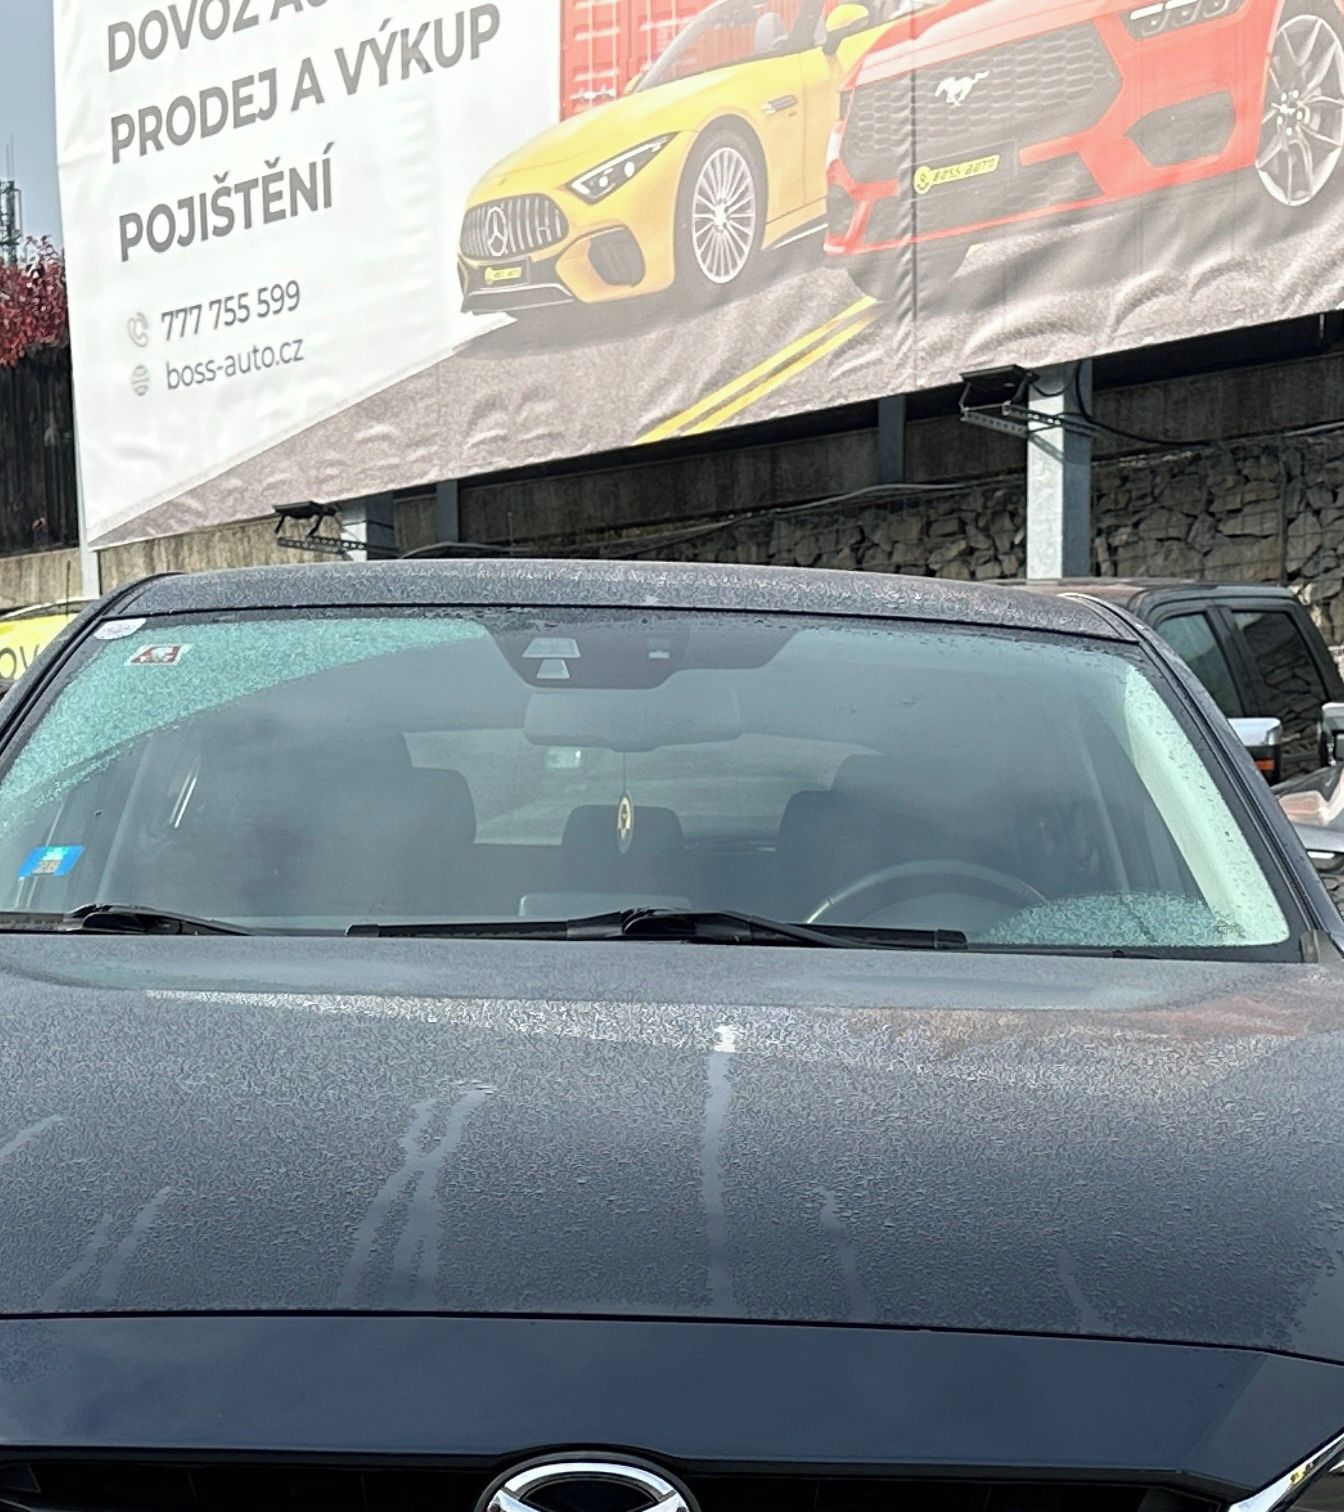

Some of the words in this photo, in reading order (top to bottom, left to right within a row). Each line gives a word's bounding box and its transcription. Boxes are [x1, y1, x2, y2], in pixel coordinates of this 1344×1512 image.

[108, 0, 259, 72] DOVOZ
[111, 67, 277, 164] PRODEJ
[291, 57, 325, 112] A
[334, 3, 500, 96] VÝKUP
[119, 141, 335, 262] POJIŠTĚNÍ
[161, 304, 202, 341] 777
[209, 292, 250, 330] 755
[257, 280, 300, 318] 599
[166, 339, 304, 390] boss-auto.cz
